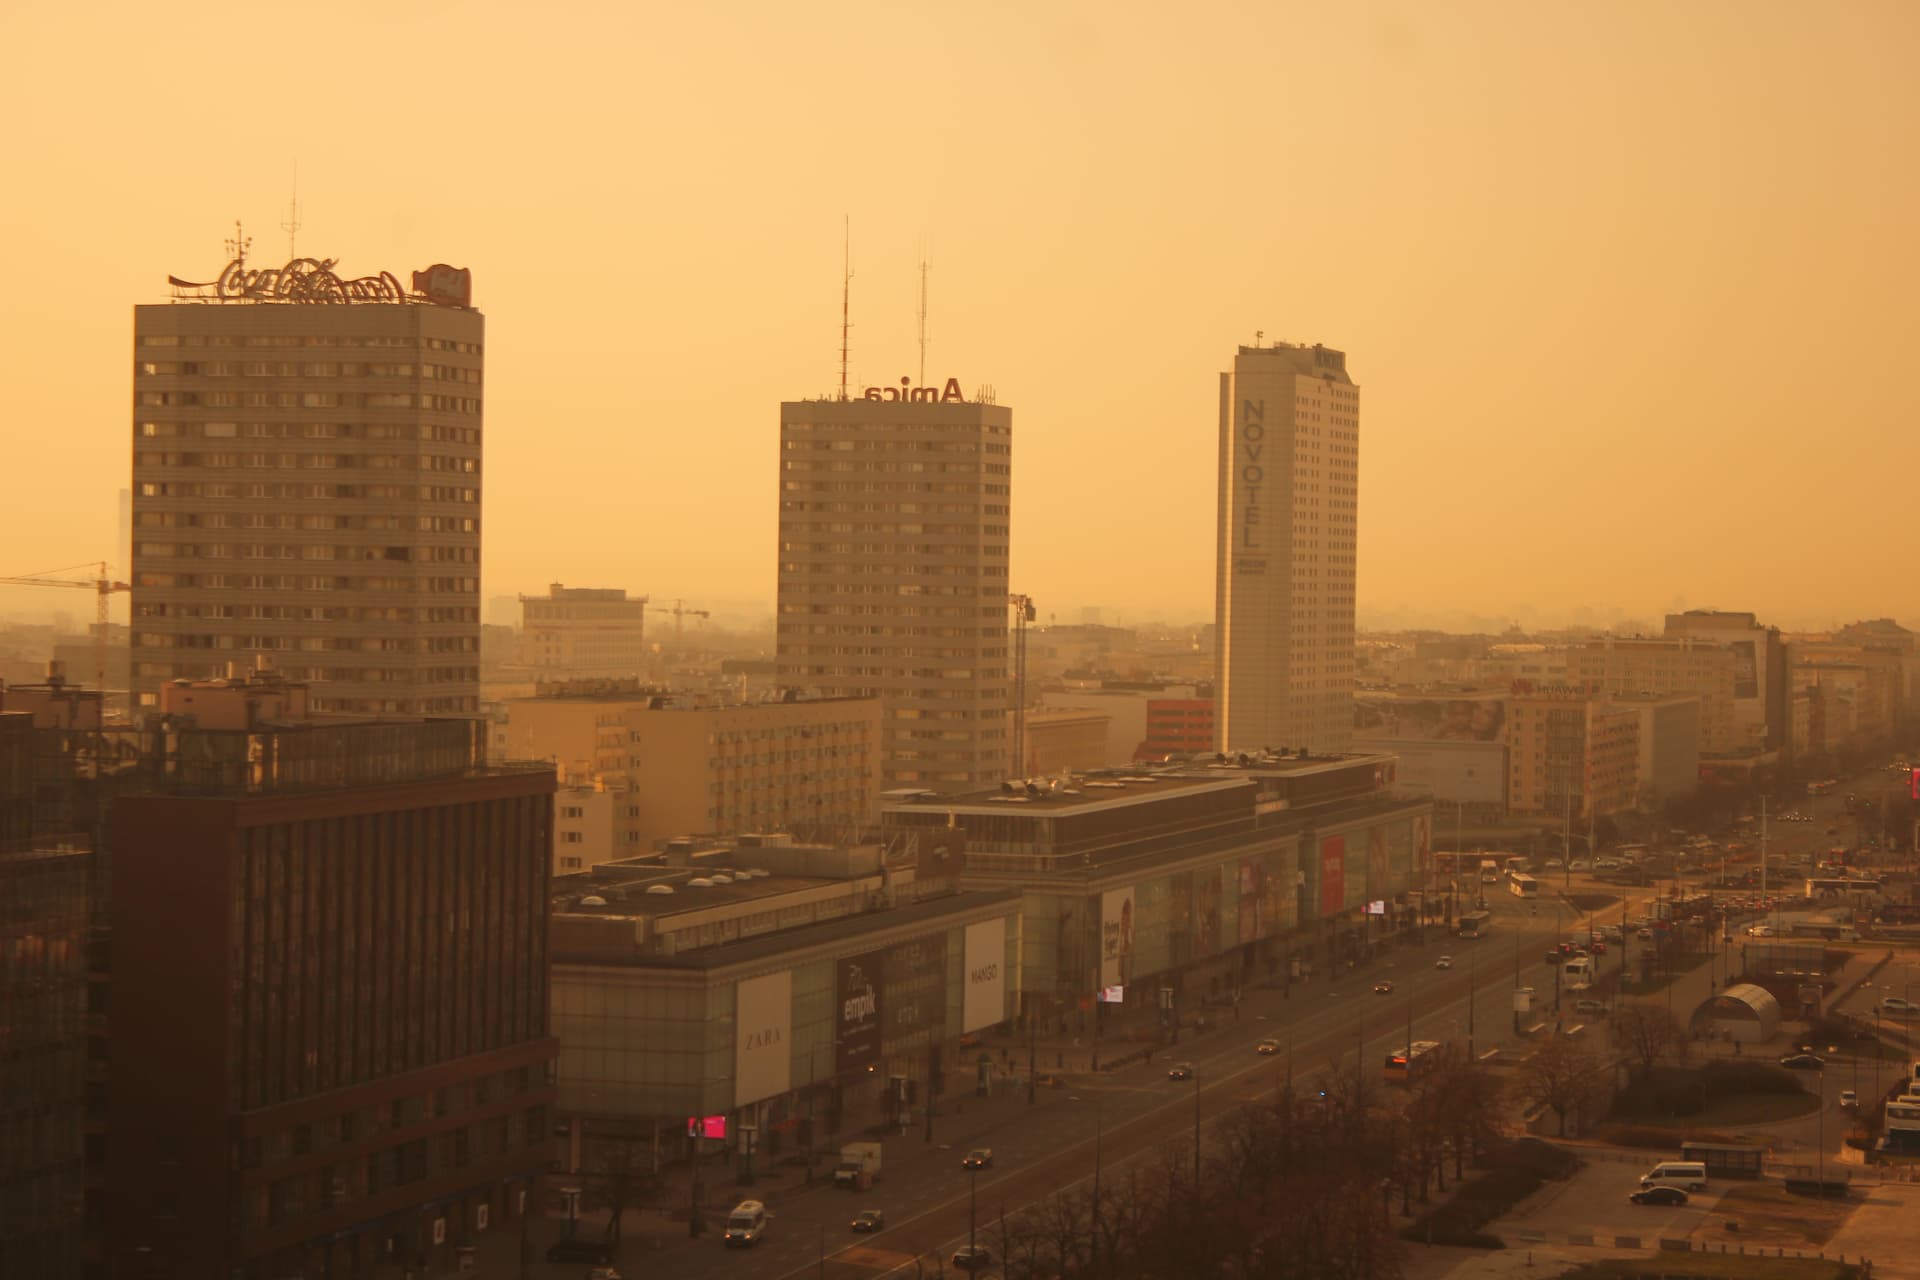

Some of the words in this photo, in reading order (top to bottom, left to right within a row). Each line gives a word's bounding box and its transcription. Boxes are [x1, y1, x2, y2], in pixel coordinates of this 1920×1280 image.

[1242, 400, 1265, 549] NOVOTEL
[971, 962, 998, 985] MANGO
[844, 983, 876, 1023] empik
[744, 1027, 782, 1052] ZARA
